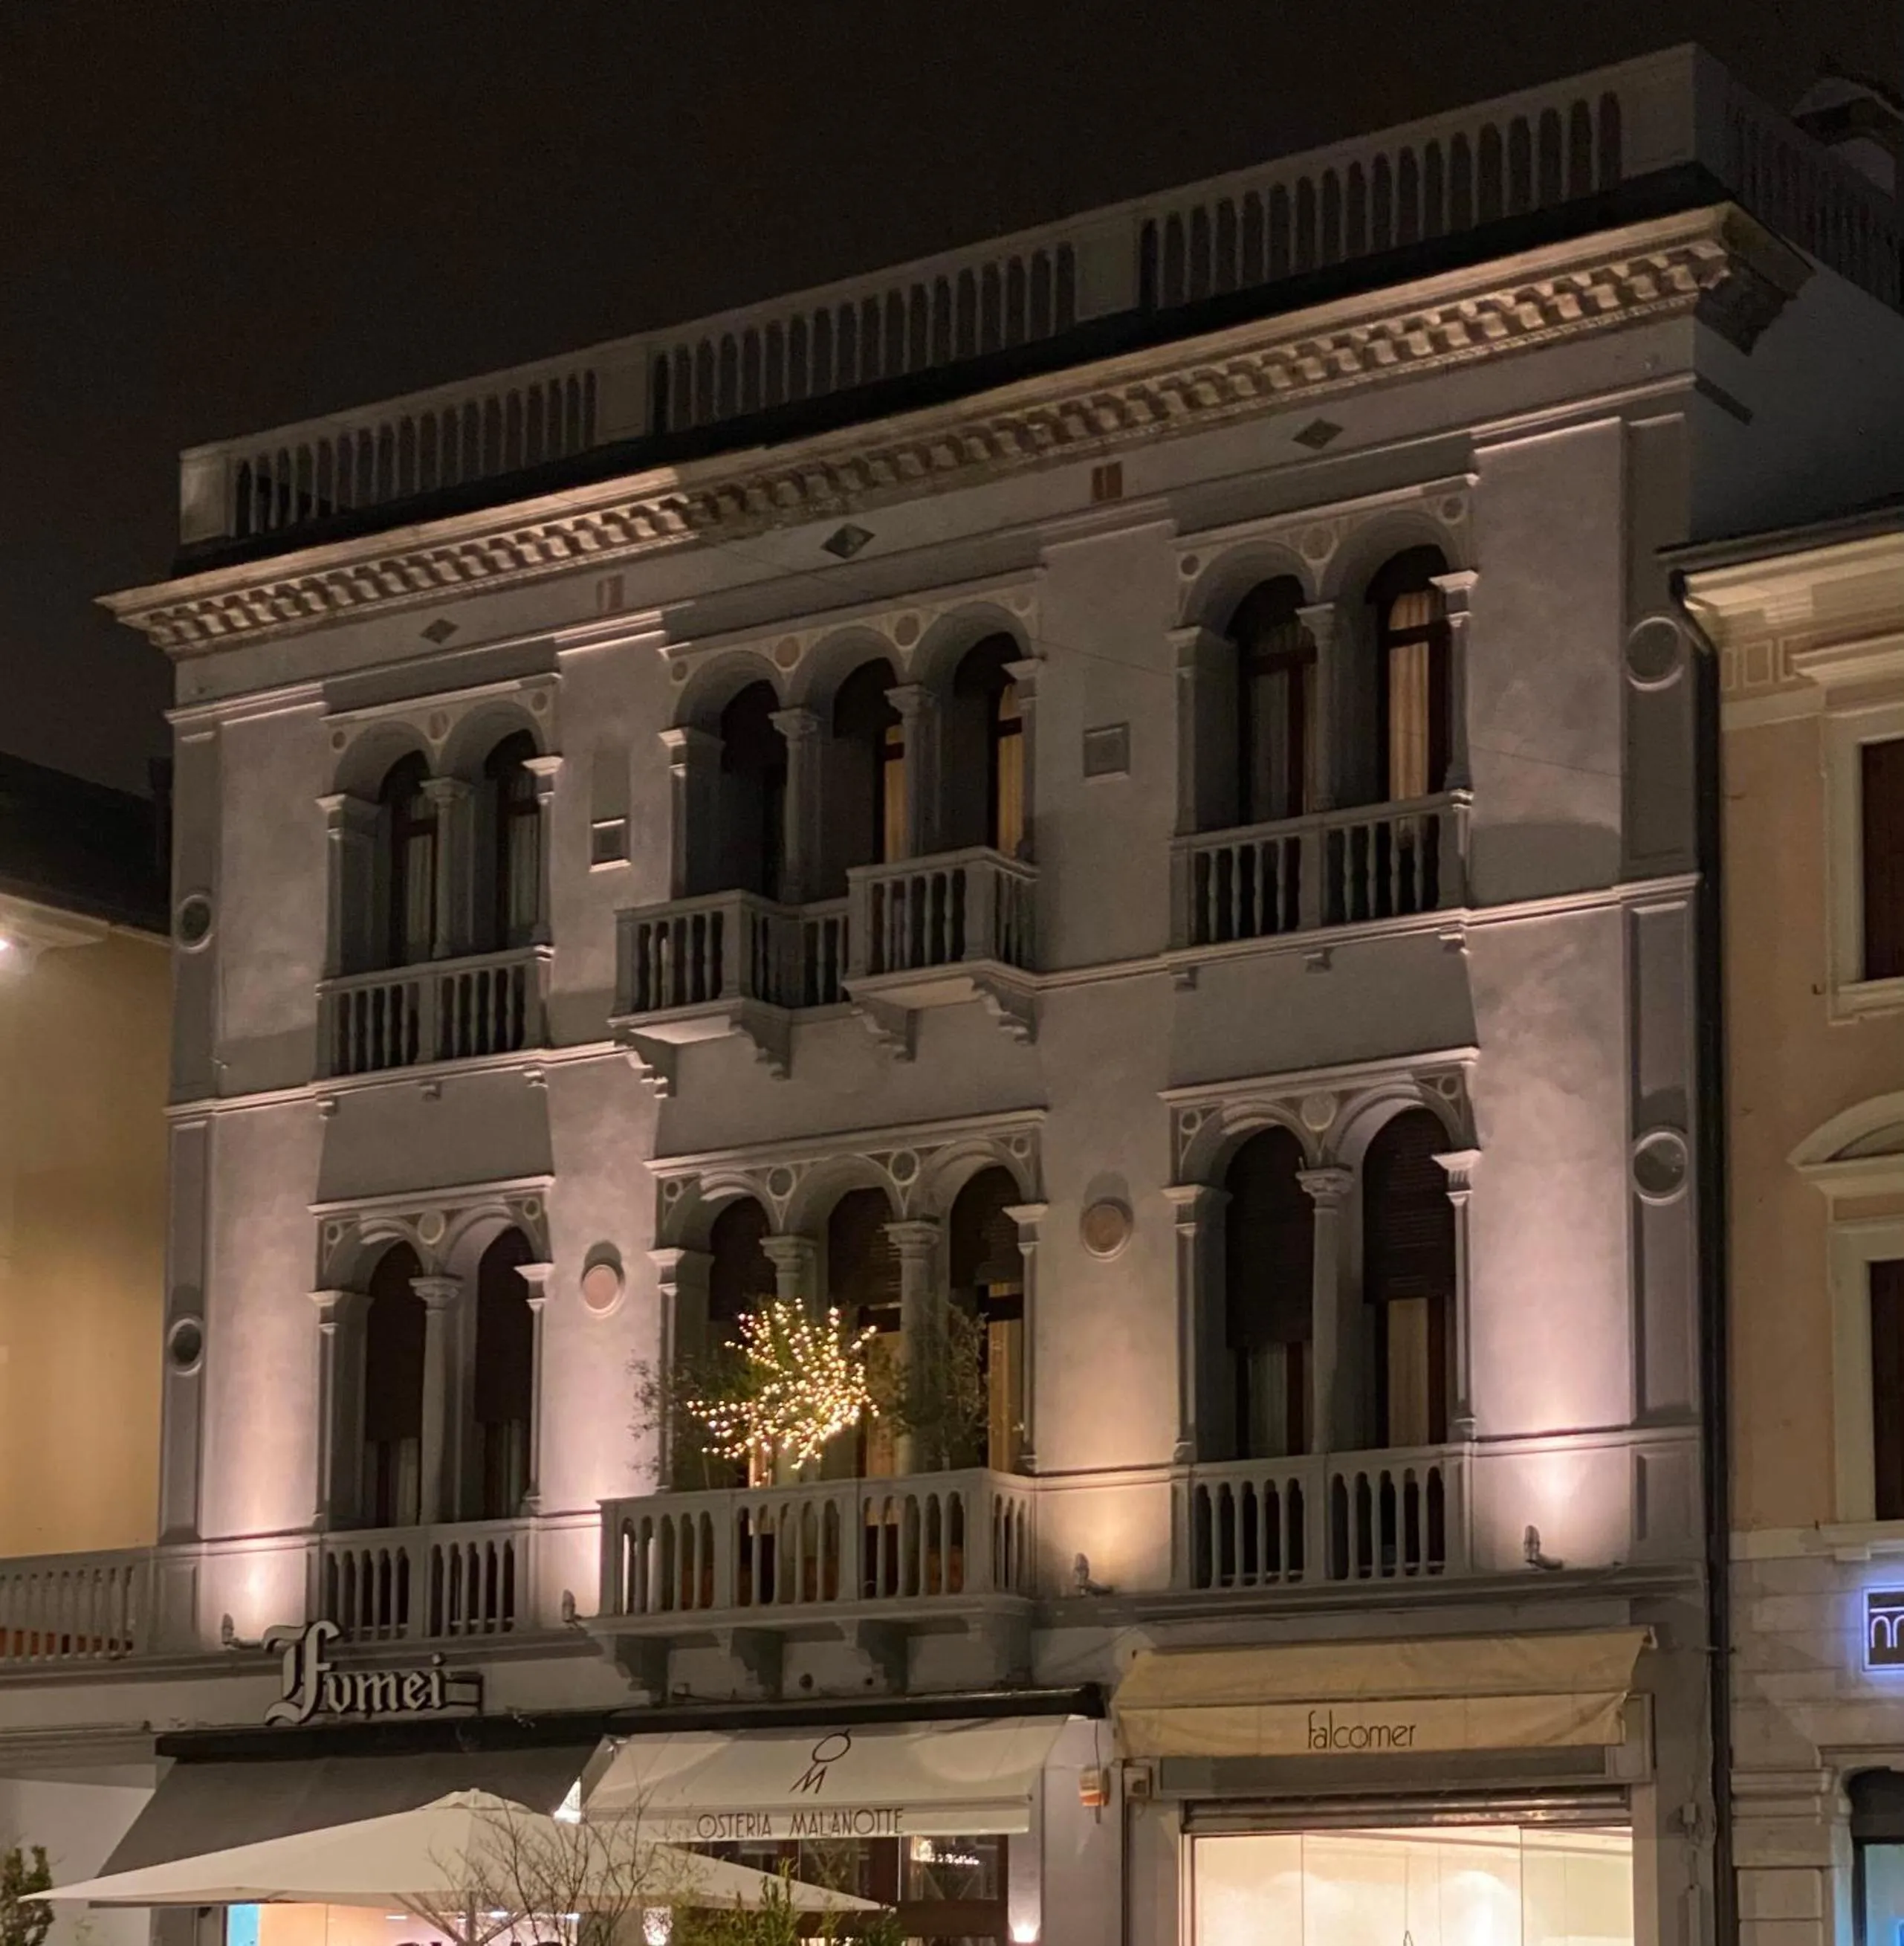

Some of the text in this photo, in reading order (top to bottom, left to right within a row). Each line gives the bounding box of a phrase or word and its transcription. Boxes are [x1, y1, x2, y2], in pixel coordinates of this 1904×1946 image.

[1308, 1709, 1416, 1749] falcomer
[696, 1808, 904, 1839] OSTERIA MALANOTTE
